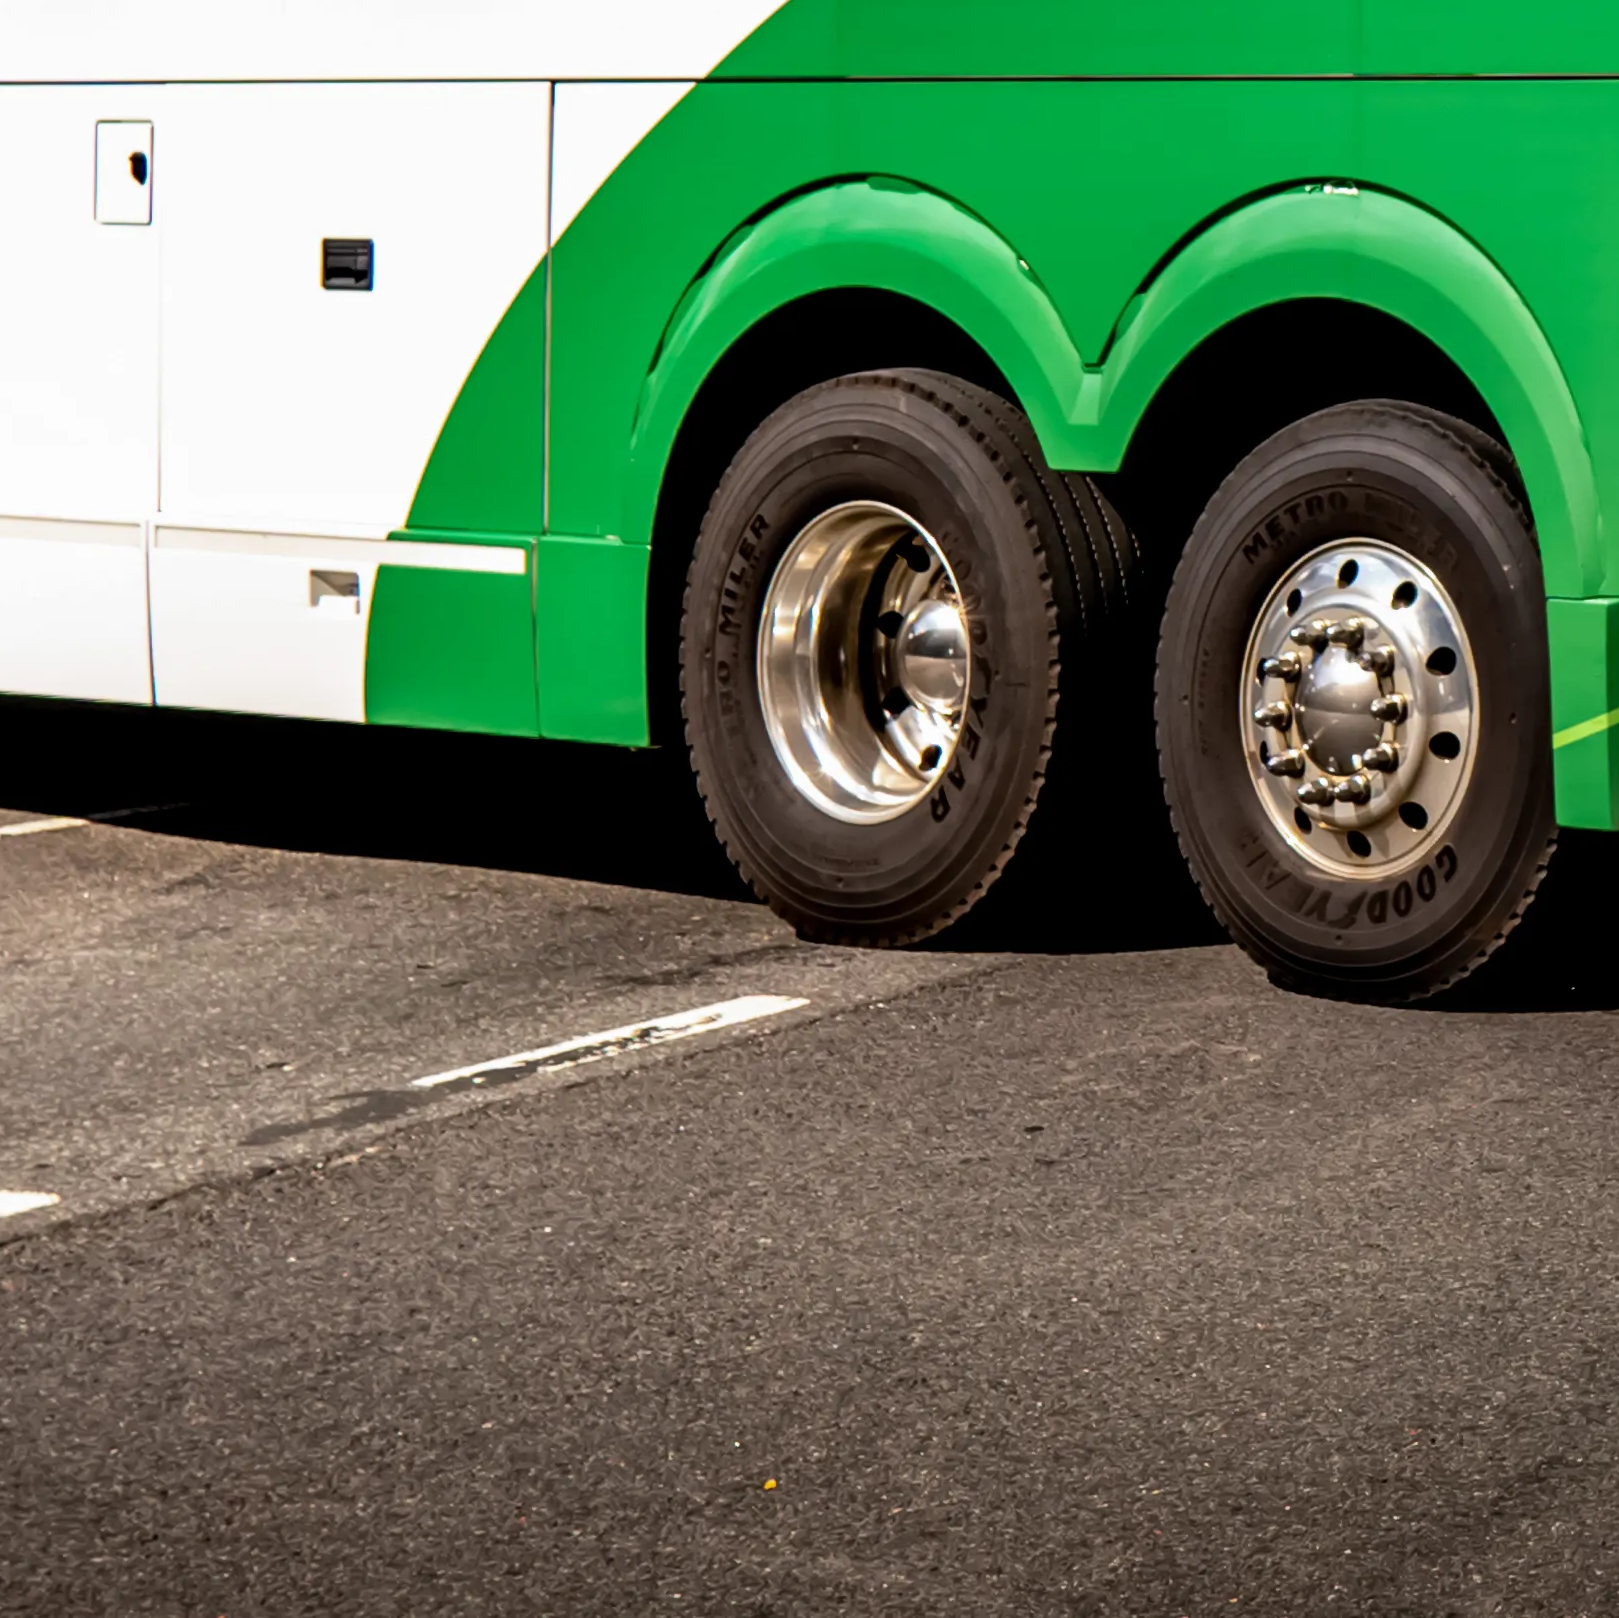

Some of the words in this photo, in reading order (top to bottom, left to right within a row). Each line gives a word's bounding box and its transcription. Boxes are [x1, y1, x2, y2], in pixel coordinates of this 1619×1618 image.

[717, 513, 770, 638] MILER
[1242, 490, 1349, 566] METRO
[1237, 831, 1458, 926] GOODYEAR
